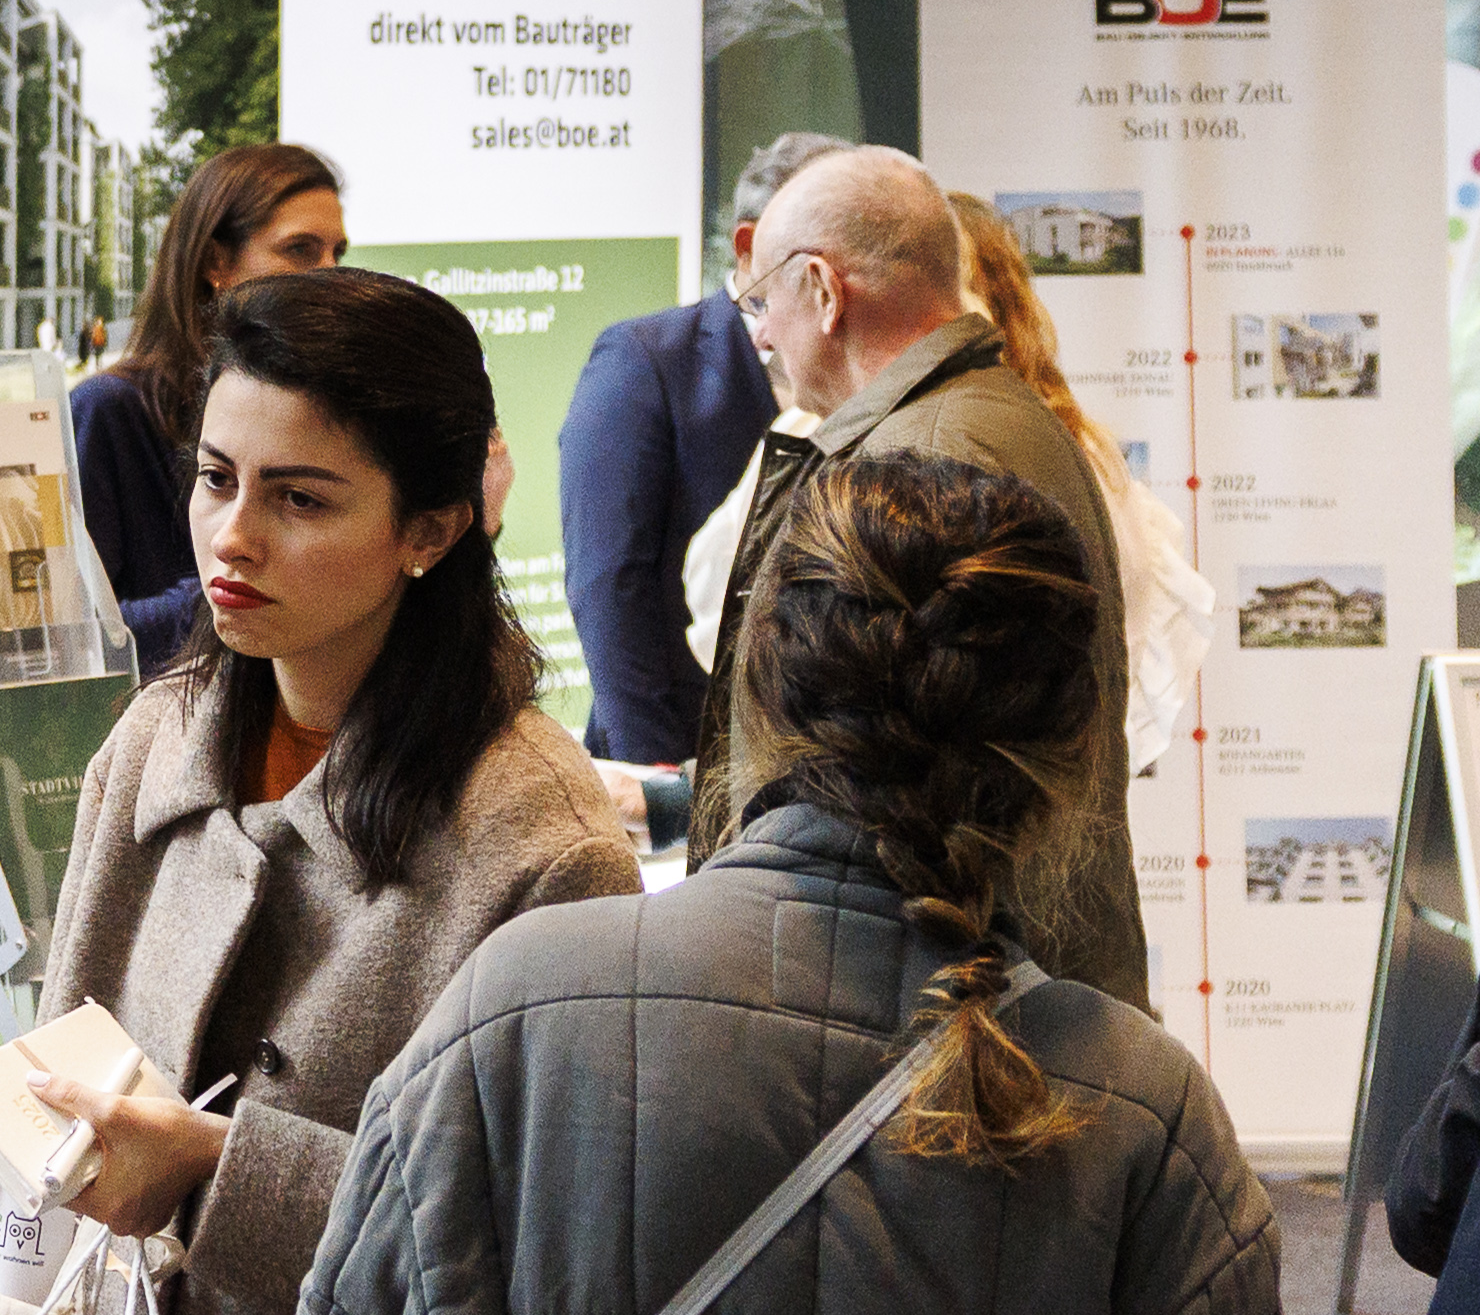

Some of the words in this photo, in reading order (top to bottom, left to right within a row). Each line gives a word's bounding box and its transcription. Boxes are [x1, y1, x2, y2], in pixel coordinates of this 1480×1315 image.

[370, 12, 444, 45] direkt
[453, 22, 505, 45] vom
[515, 14, 633, 54] Bauträger
[473, 65, 515, 97] Tel:
[524, 66, 631, 101] 01/71180
[1077, 85, 1119, 106] Am
[1127, 82, 1182, 105] Puls
[1190, 81, 1229, 104] der
[472, 117, 631, 149] sales@boe.at
[1123, 117, 1168, 140] Seit
[1181, 117, 1246, 140] 1968.
[424, 266, 559, 295] Gallitzinstraße
[561, 265, 584, 293] 12
